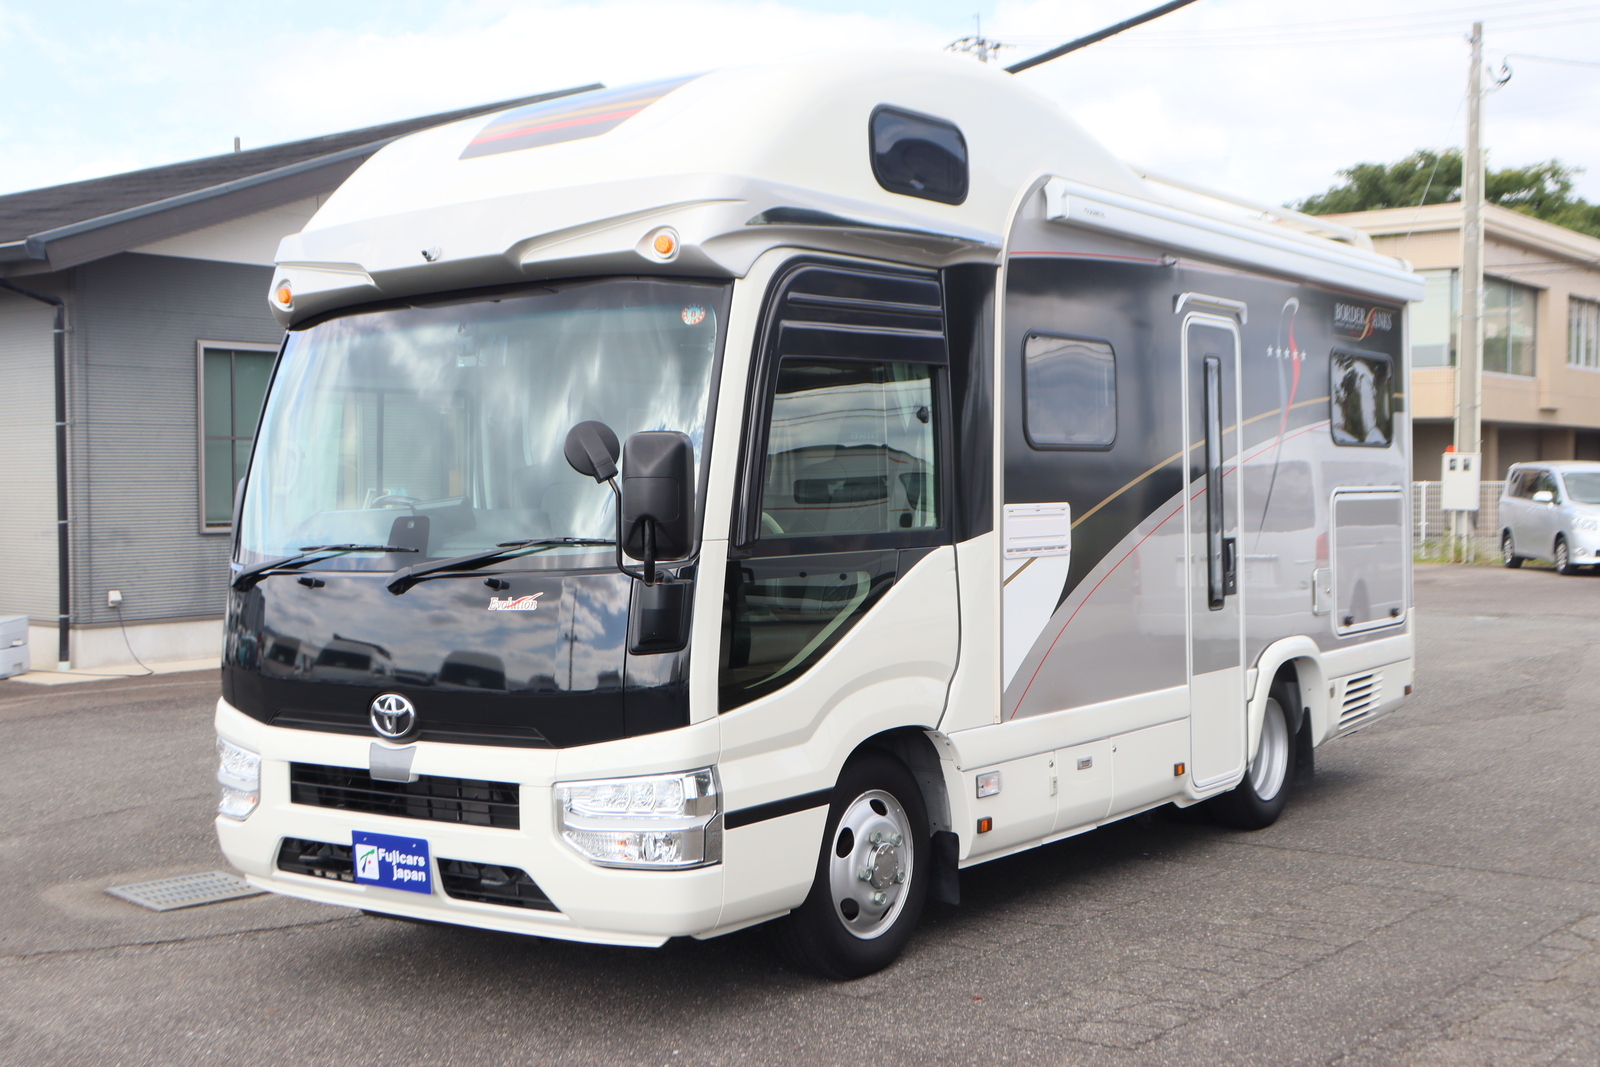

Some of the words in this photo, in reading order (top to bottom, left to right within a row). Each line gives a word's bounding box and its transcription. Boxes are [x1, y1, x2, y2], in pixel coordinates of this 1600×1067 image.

[1334, 303, 1366, 325] BORDER
[488, 596, 538, 610] Evolution
[378, 848, 426, 867] Fujicars
